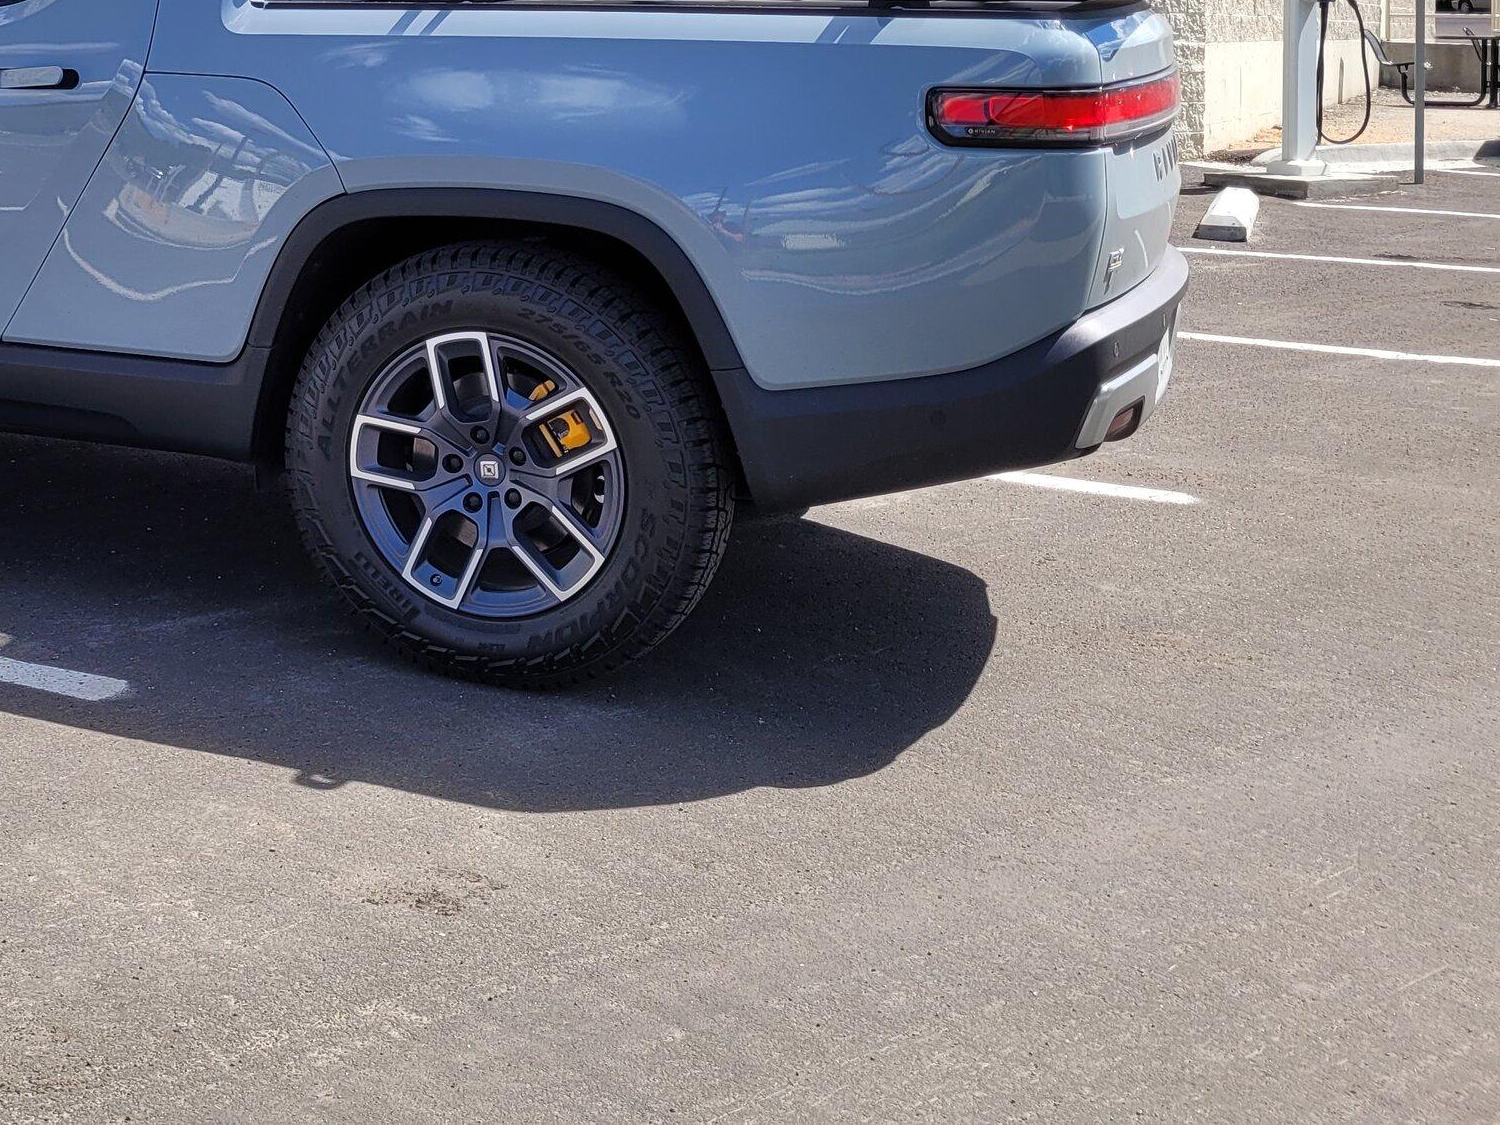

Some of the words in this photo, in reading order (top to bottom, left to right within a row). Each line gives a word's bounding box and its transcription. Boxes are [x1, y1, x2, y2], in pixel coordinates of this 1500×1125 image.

[317, 394, 342, 462] ALL
[332, 299, 454, 393] TERRAIN
[518, 306, 607, 366] 275/65
[602, 371, 641, 419] R20
